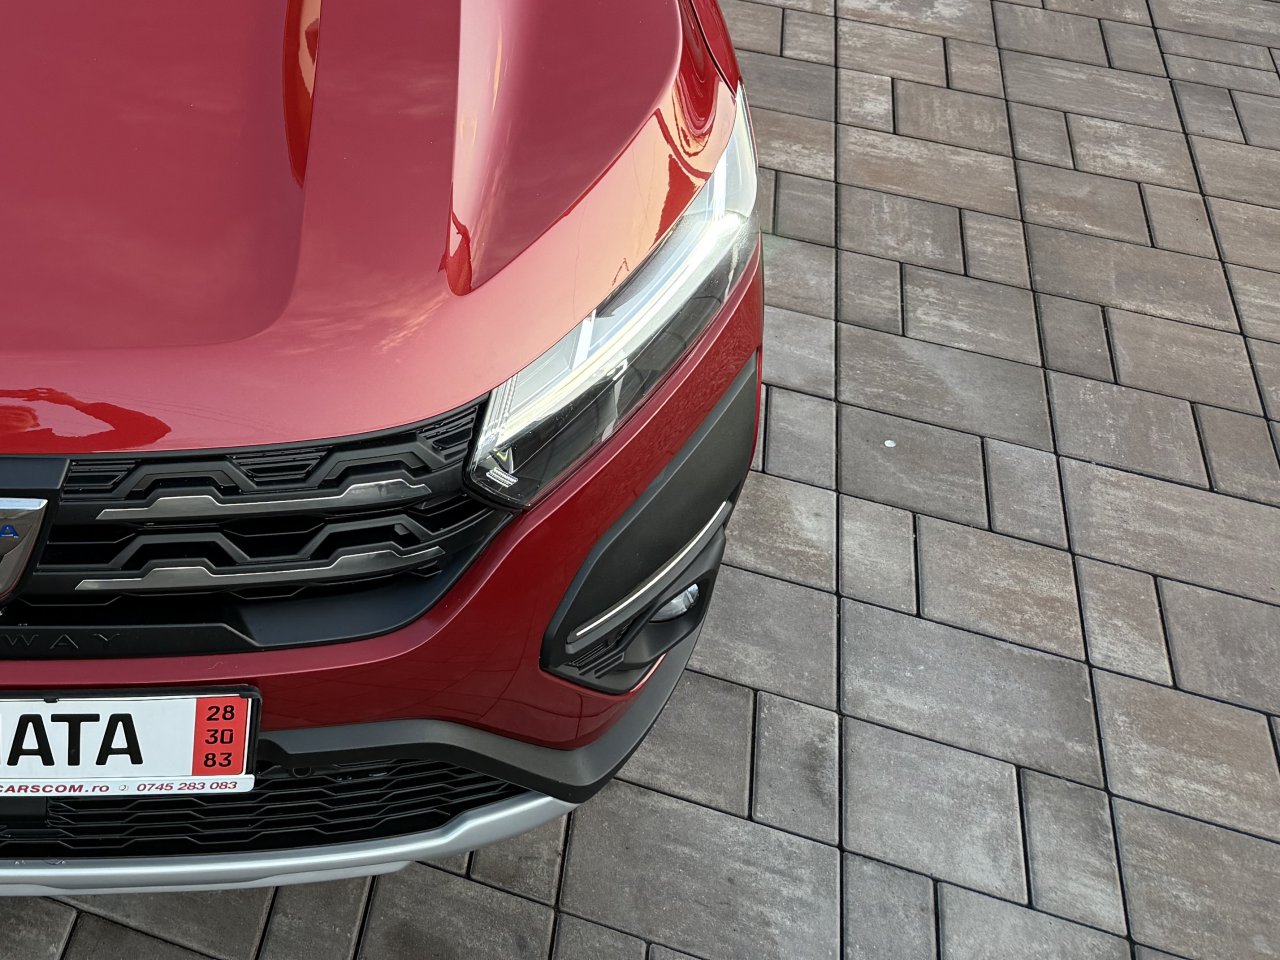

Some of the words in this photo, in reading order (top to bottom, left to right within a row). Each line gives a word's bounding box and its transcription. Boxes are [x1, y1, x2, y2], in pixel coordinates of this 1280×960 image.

[205, 705, 236, 722] 28
[204, 728, 234, 746] 30
[202, 751, 233, 768] 83
[136, 782, 174, 792] 0745
[177, 781, 206, 791] 283
[209, 781, 238, 791] 083
